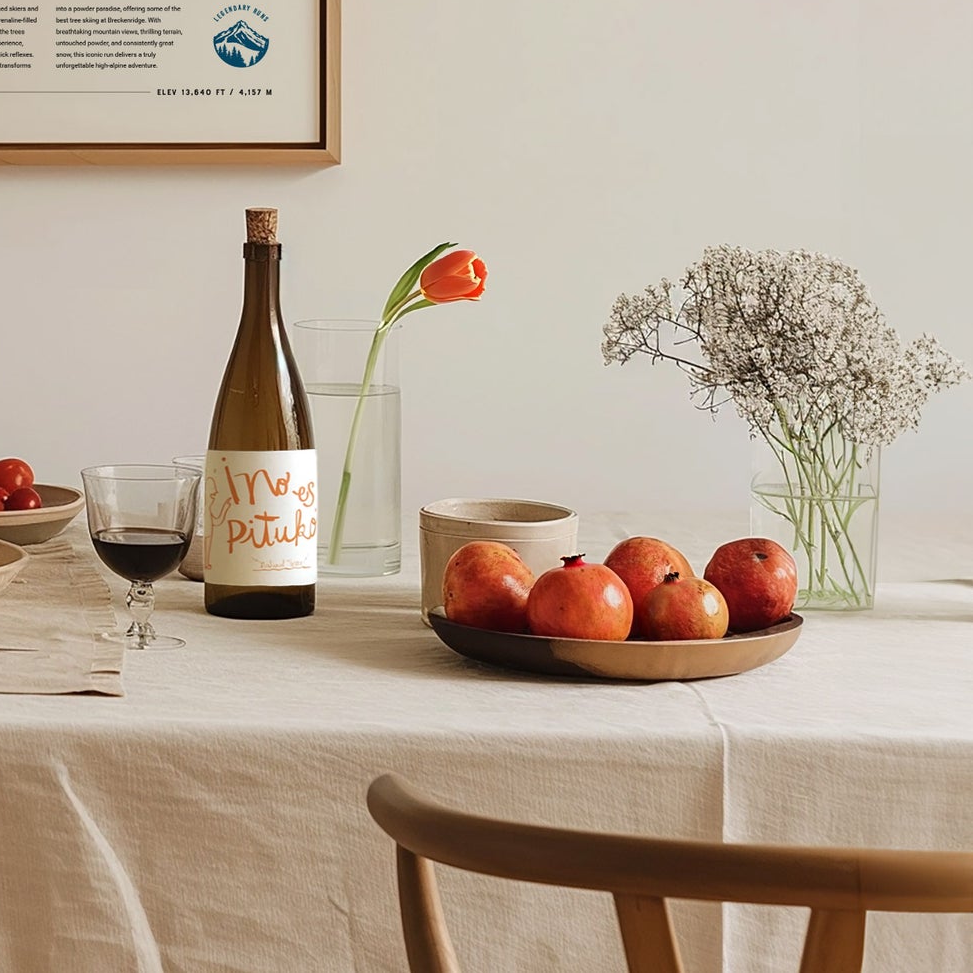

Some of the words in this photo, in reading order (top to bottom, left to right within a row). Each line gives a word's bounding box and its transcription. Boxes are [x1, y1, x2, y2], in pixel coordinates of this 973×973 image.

[213, 4, 251, 22] LEGENDARY
[252, 7, 269, 22] RUNS
[157, 88, 177, 96] ELEV
[181, 88, 212, 96] 13,640
[215, 88, 225, 96] FT
[239, 88, 262, 96] 4,157
[265, 88, 272, 96] M
